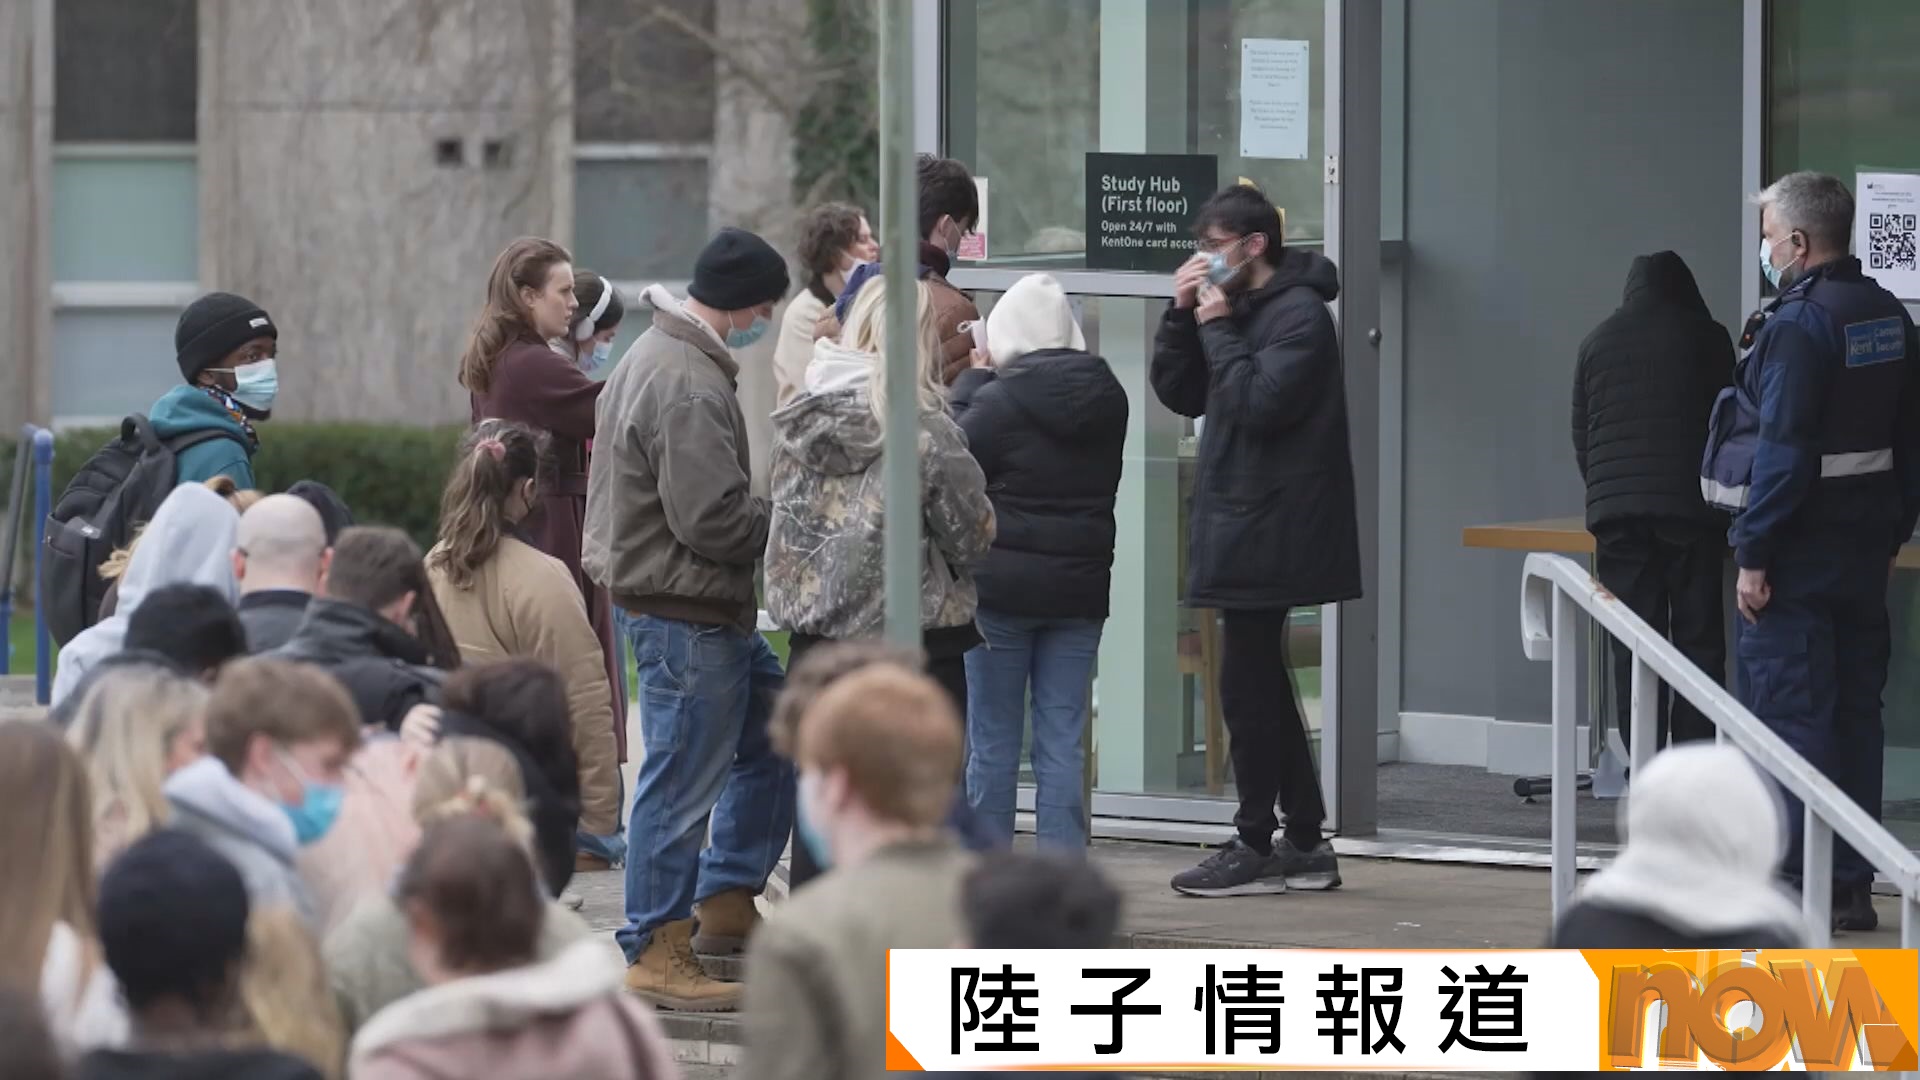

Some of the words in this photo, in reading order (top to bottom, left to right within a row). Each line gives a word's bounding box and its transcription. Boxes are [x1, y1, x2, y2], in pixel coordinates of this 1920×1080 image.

[1101, 174, 1146, 195] Study
[1150, 176, 1181, 193] Hub
[1101, 195, 1142, 214] (First
[1146, 196, 1188, 215] floor)
[1101, 220, 1127, 234] Open
[1129, 221, 1153, 233] 24/7
[1156, 221, 1177, 233] with
[1101, 236, 1143, 248] KentOne
[1146, 237, 1168, 248] card
